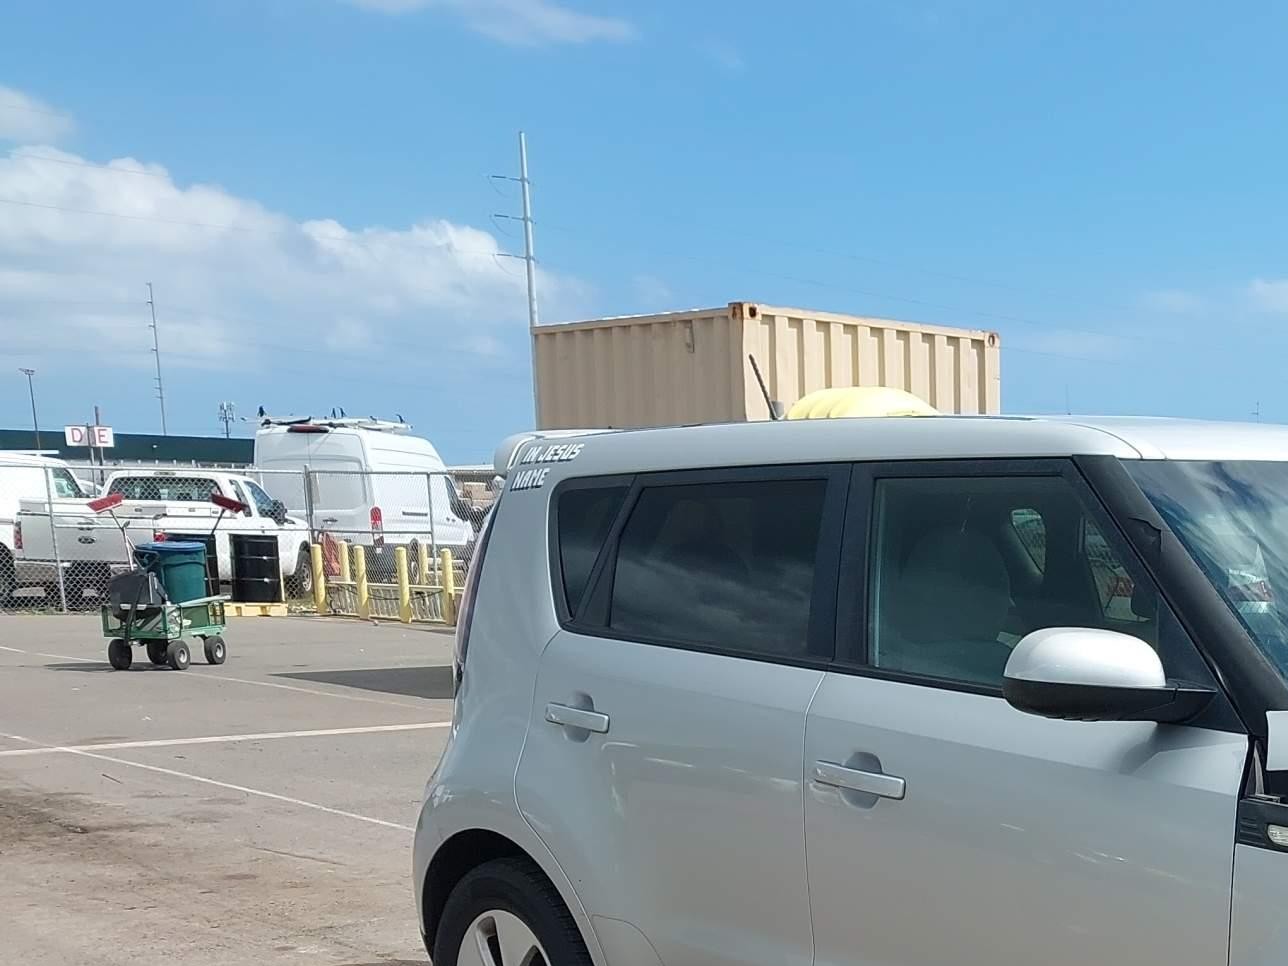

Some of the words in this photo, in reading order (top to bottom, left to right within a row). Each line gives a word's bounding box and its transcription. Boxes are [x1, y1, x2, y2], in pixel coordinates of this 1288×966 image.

[520, 446, 542, 464] IN
[537, 443, 585, 463] JESUS
[510, 467, 550, 491] NAME
